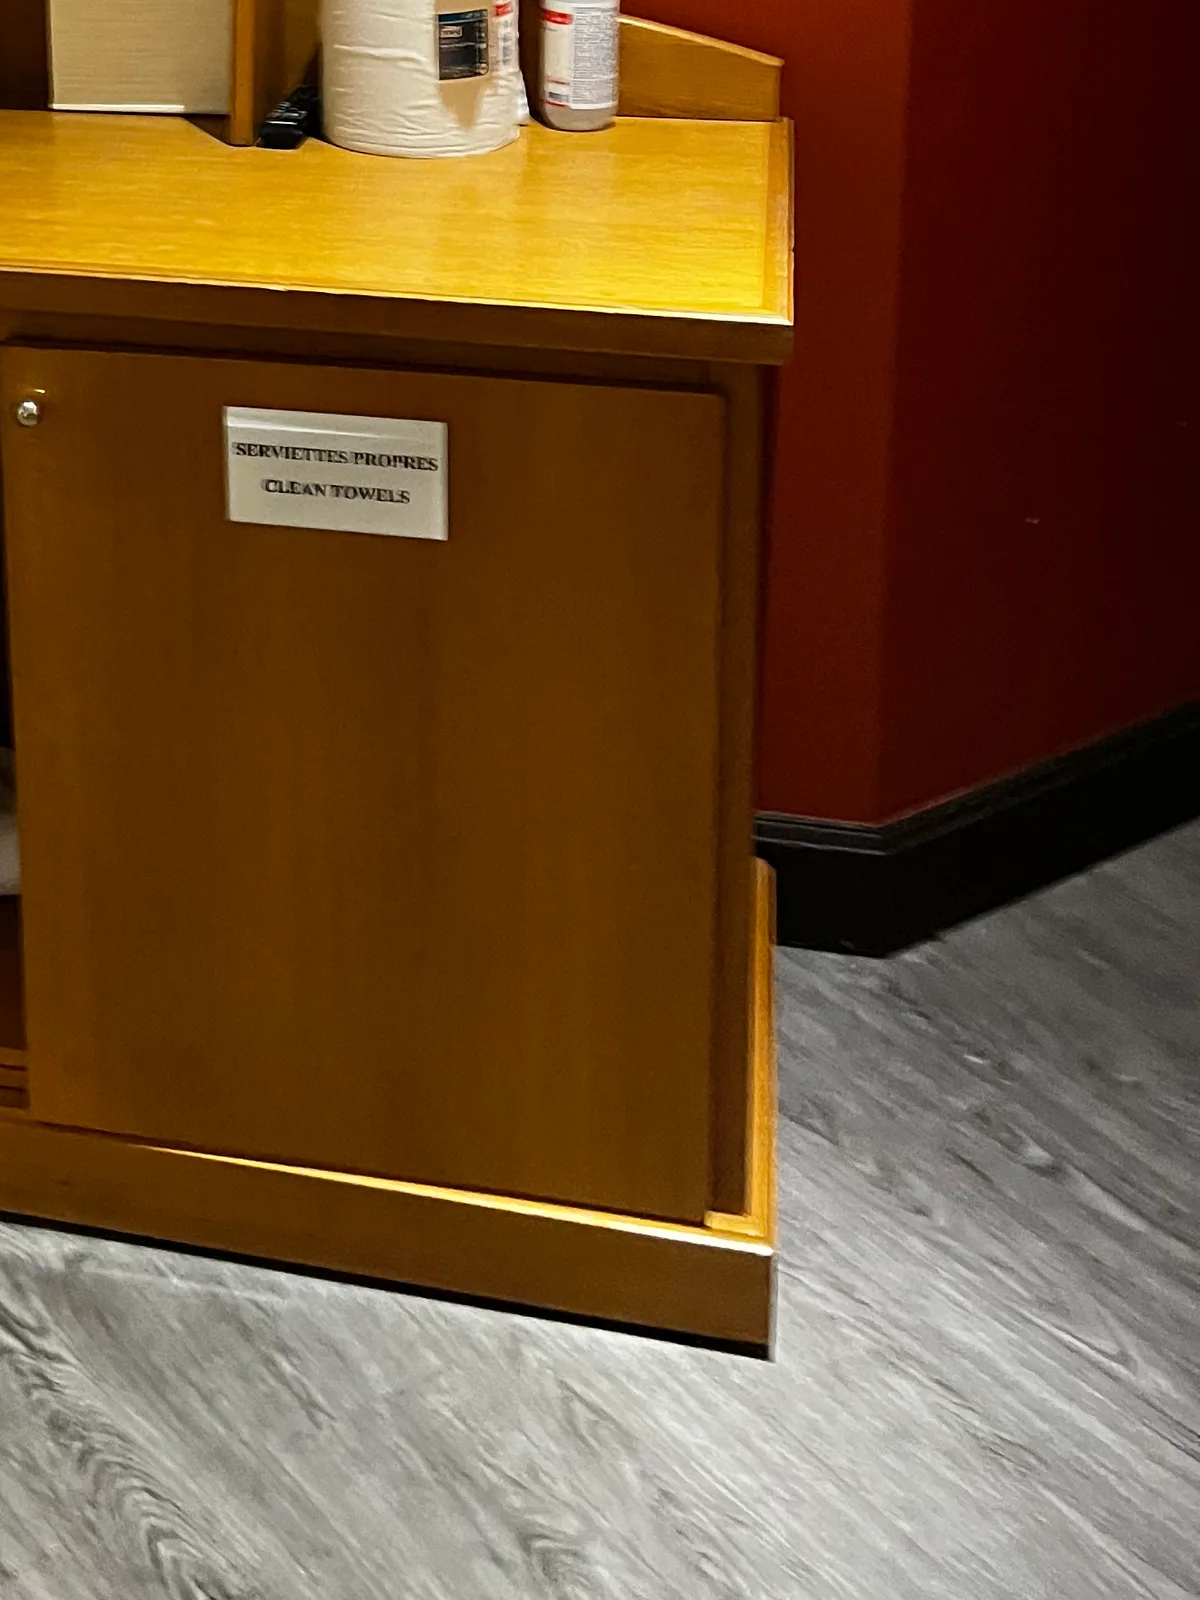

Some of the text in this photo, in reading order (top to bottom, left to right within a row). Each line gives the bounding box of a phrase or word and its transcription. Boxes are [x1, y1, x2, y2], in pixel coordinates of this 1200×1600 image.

[233, 442, 439, 471] SERVIETTES PROPRES
[262, 478, 411, 504] CLEAN TOWELS
